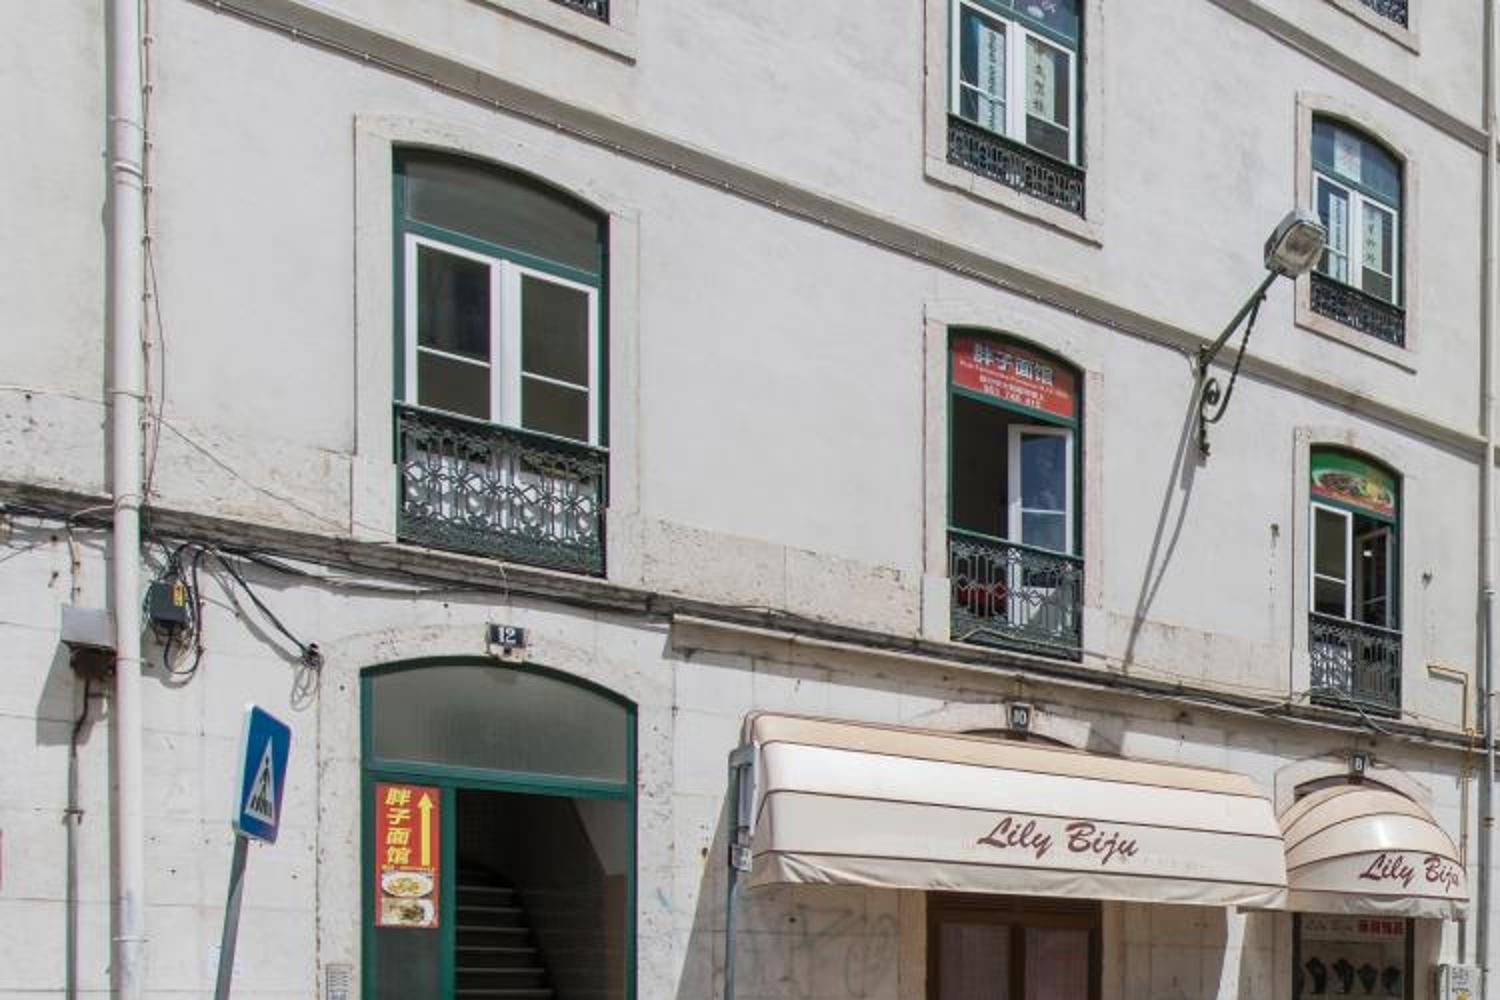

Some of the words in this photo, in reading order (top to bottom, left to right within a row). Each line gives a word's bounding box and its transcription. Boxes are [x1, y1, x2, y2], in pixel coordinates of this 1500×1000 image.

[498, 627, 516, 643] 12
[1014, 709, 1027, 725] 10
[385, 787, 412, 865] 胖子面馆
[977, 816, 1053, 860] Lily
[1065, 822, 1139, 866] Biju
[1359, 853, 1415, 889] Lily
